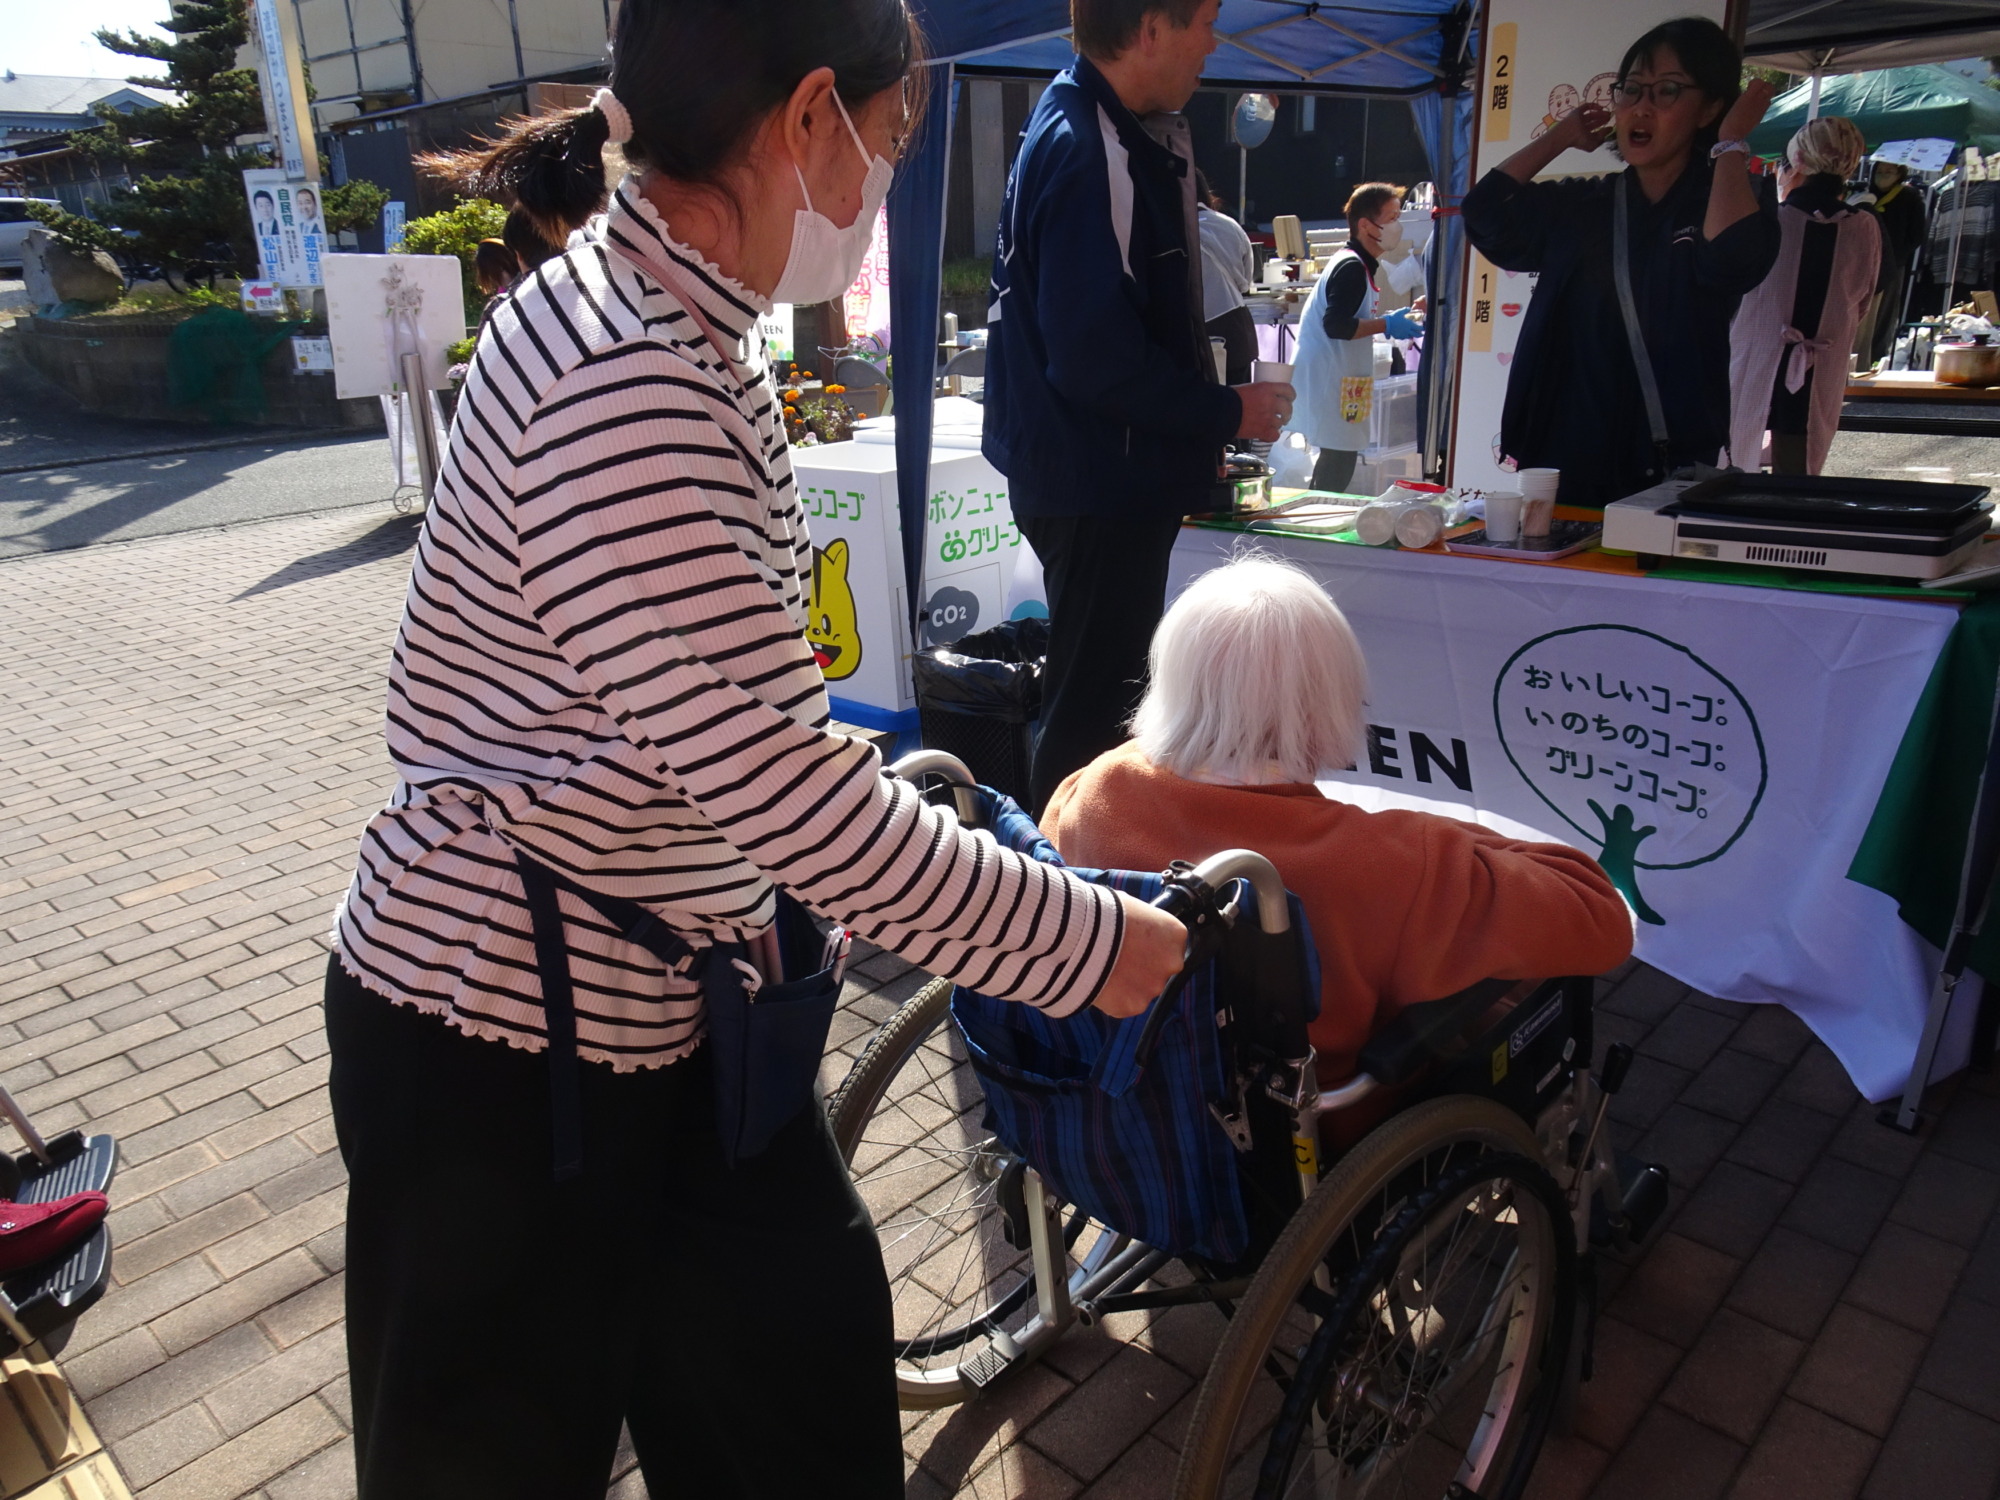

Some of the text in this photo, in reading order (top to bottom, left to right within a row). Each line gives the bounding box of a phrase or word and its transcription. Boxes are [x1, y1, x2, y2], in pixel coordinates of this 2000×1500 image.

[1491, 54, 1510, 112] 2階
[277, 188, 295, 227] 自民党
[262, 236, 279, 282] 松山まさ
[1474, 273, 1491, 324] 1階
[897, 487, 1006, 531] ボンニュー
[931, 605, 968, 628] CO2
[1523, 664, 1728, 726] おいしいコープ。
[1345, 723, 1473, 793] EN
[1525, 706, 1727, 772] いのちのコープ。
[1546, 746, 1708, 819] グリーンコープ。
